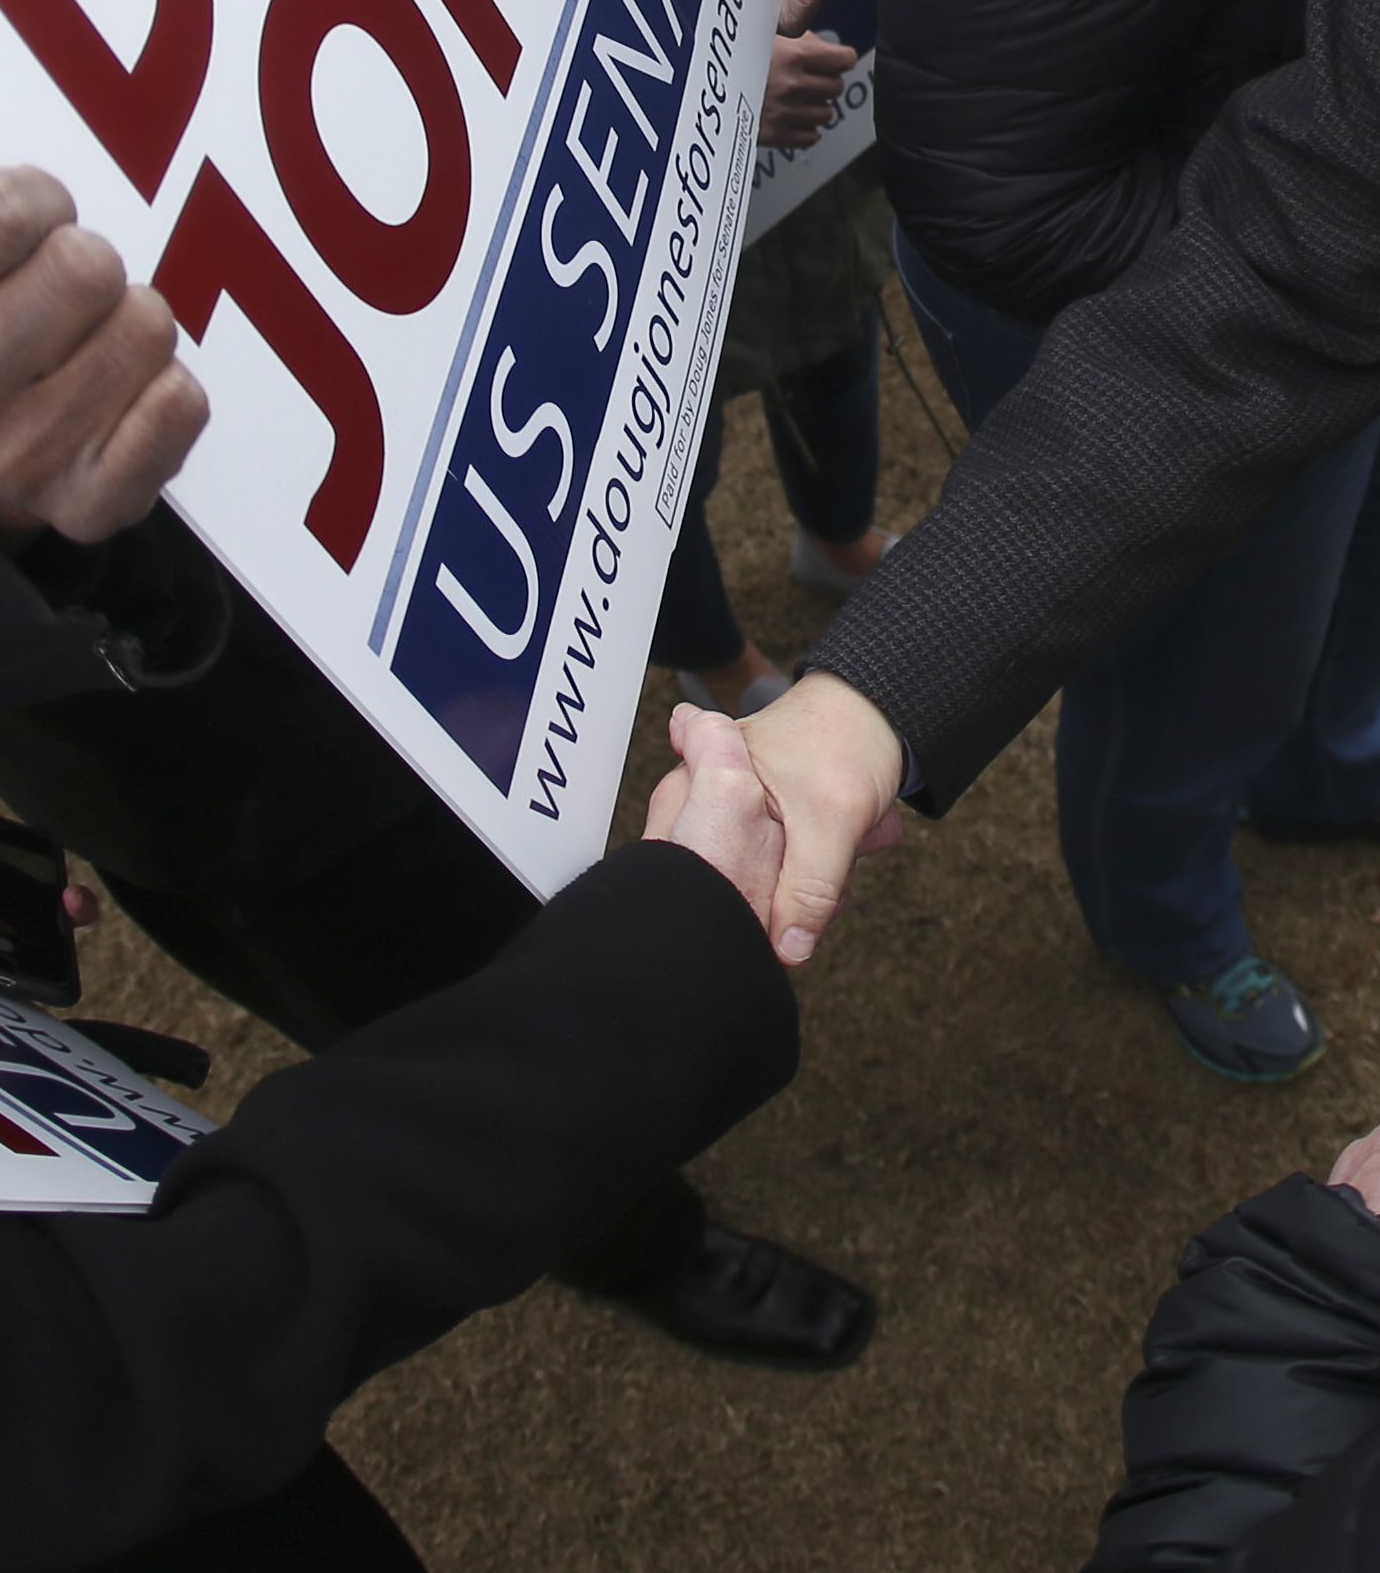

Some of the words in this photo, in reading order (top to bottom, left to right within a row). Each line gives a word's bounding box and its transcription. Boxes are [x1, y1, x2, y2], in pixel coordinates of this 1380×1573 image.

[435, 344, 577, 661] US
[661, 461, 680, 510] Paid
[673, 429, 688, 465] for
[681, 399, 695, 428] by
[688, 348, 707, 398] Doug
[701, 290, 719, 345] Jones
[712, 259, 726, 289] for
[719, 197, 736, 261] Senate
